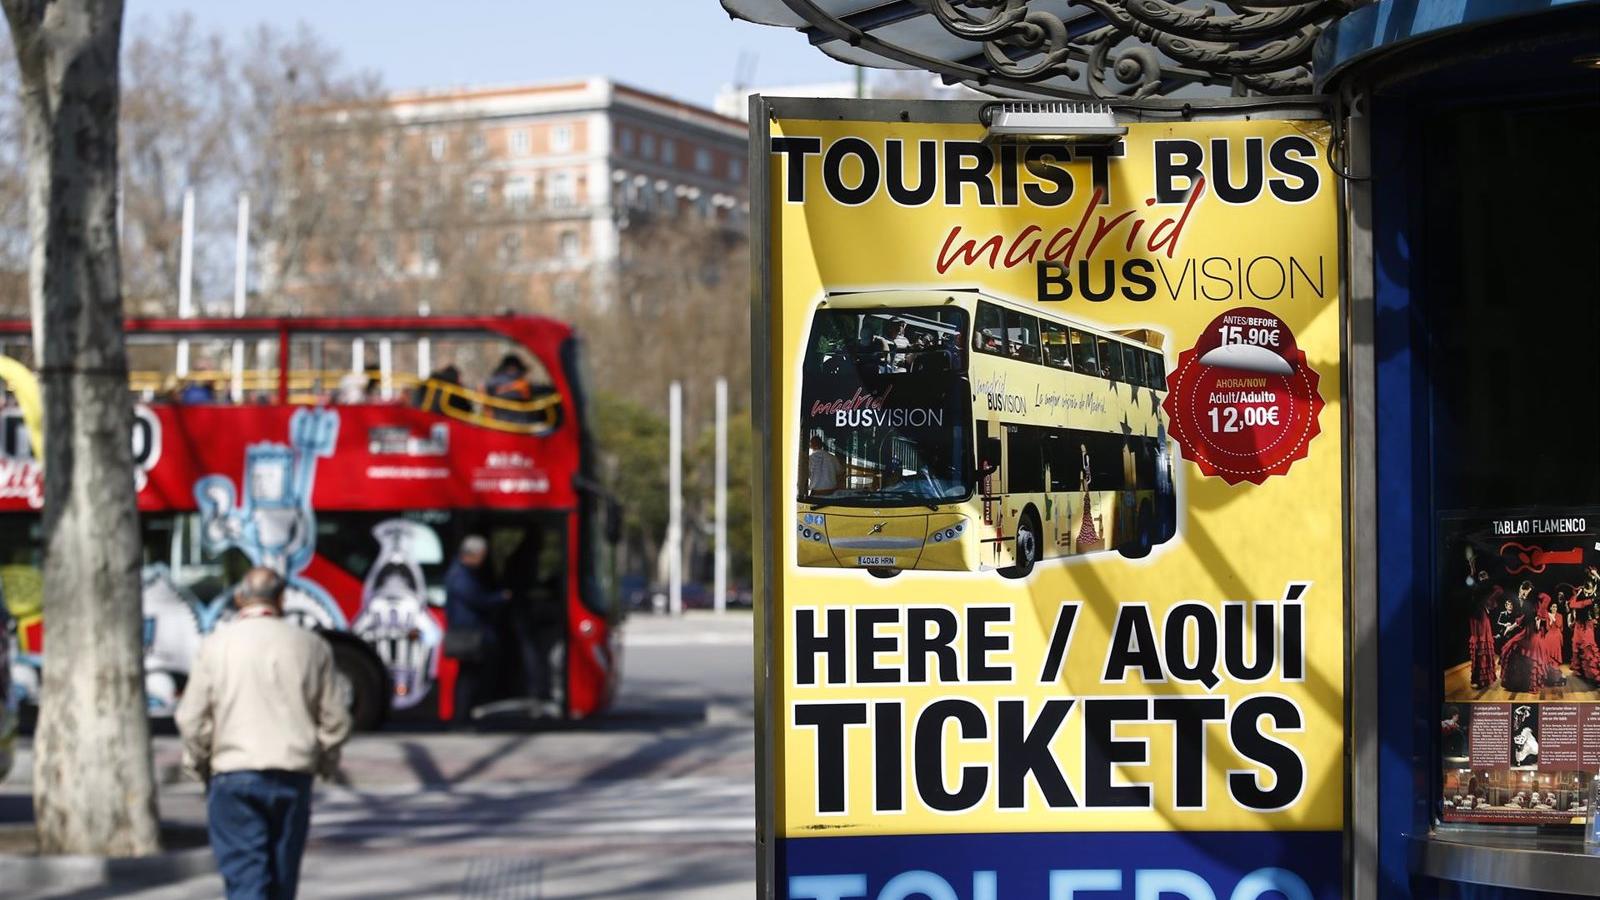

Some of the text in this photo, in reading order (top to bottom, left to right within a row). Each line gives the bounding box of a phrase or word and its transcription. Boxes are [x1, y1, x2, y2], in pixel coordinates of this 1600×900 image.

[770, 136, 1319, 206] TOURIST BUS
[935, 177, 1206, 274] madrid
[1036, 255, 1325, 303] BUSVISION
[1223, 316, 1278, 328] ANTES/BEFORE
[1208, 391, 1276, 404] Adult/Adulto
[1216, 378, 1267, 389] AHORA/NOW
[810, 384, 893, 417] madrid
[835, 408, 943, 427] BUSVISION
[1207, 405, 1280, 433] 12,00€
[1493, 518, 1586, 535] TABLAO FLAMENCO
[795, 606, 1013, 684] HERE
[1104, 584, 1310, 690] AQUÍ
[794, 697, 1305, 813] TICKETS
